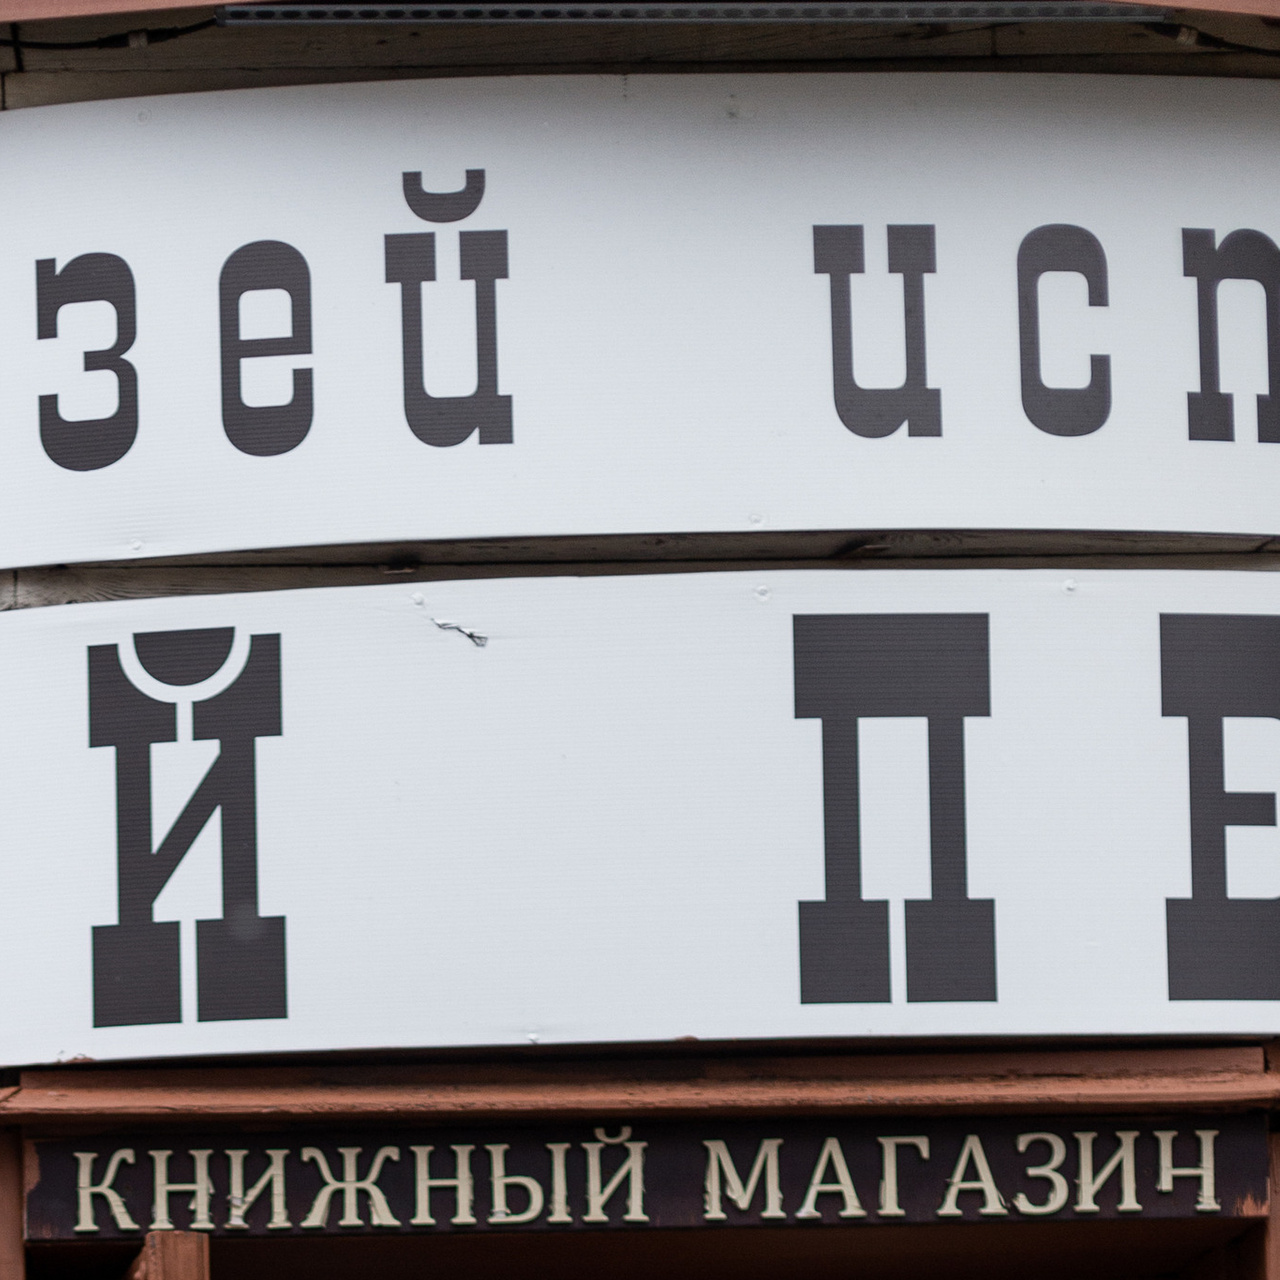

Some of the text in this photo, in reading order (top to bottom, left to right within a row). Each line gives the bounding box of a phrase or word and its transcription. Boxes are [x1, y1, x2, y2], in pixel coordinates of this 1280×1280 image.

[792, 612, 1280, 1005] ПЕ
[73, 1125, 1222, 1233] КНИЖНЫЙ МАГАЗИН
